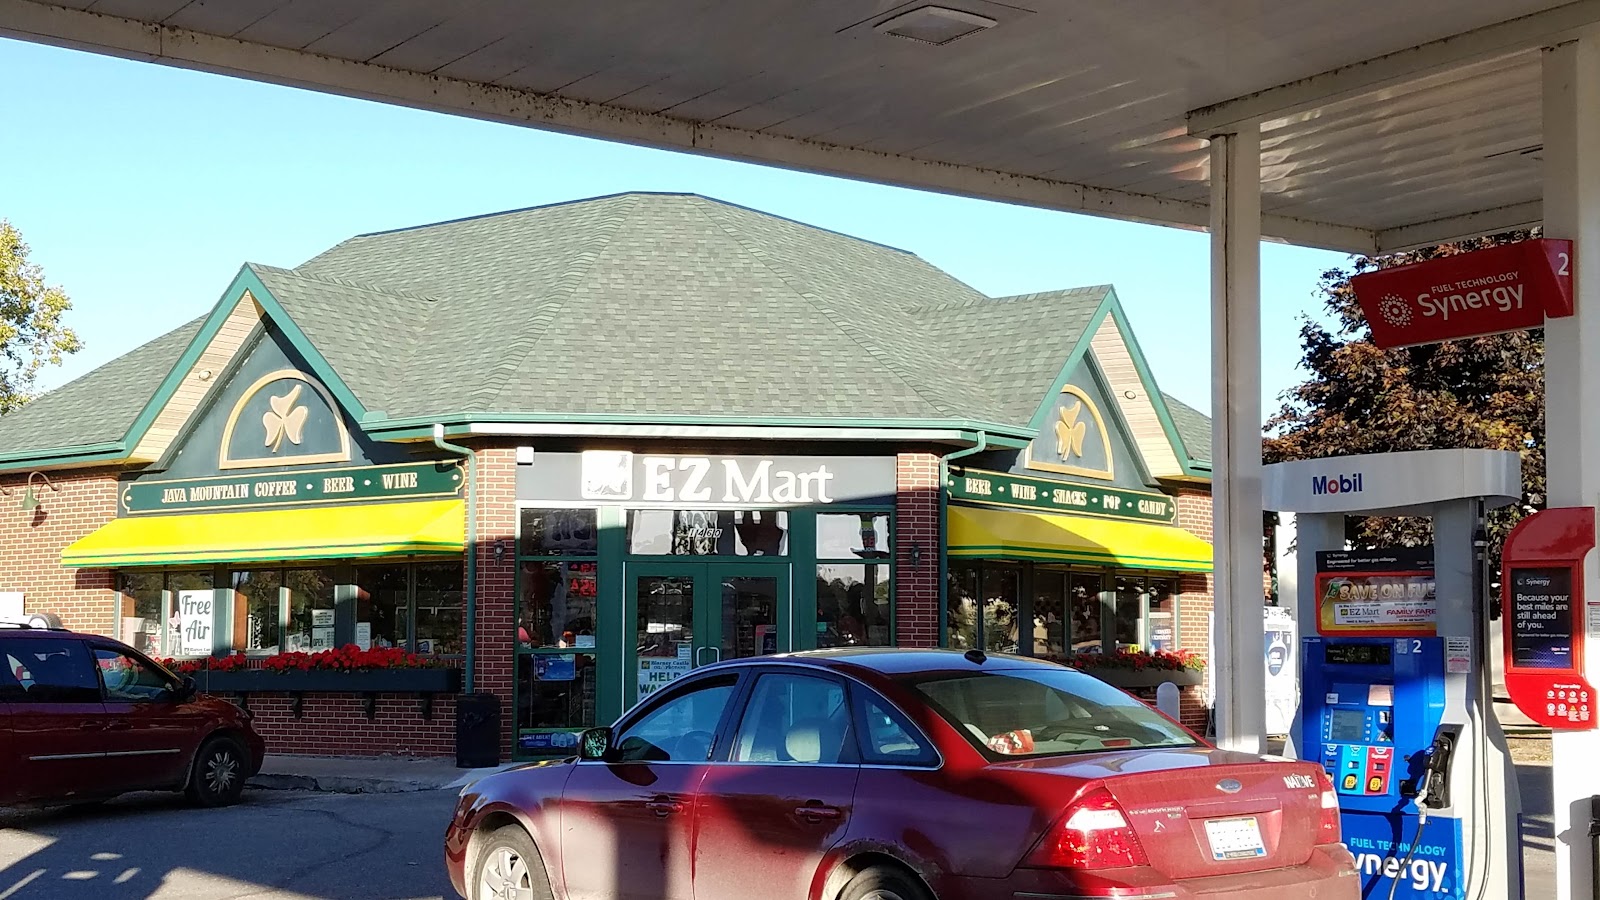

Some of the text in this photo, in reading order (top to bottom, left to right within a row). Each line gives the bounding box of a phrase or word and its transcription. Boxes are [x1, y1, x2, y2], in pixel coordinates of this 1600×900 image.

[1557, 252, 1570, 276] 2
[1431, 271, 1519, 294] FUEL TECHNOLOGY
[1417, 284, 1524, 320] Synergy
[161, 472, 418, 503] JAVA MOUNTAIN COFFEE BEER WINE
[643, 457, 834, 503] EZ Mart
[1312, 473, 1363, 495] Mobil
[965, 477, 1167, 516] BEER WINE SNACKS POP CANDY
[688, 527, 723, 538] 1460
[1340, 582, 1436, 600] SAVE ON FUE
[1525, 578, 1551, 586] Synergy
[181, 594, 211, 615] Free
[1516, 602, 1534, 610] best
[1534, 602, 1554, 610] miles
[1550, 595, 1569, 603] your
[1349, 608, 1380, 616] EZ Mart
[1516, 611, 1557, 619] still ahead
[185, 619, 210, 642] Air
[1516, 620, 1544, 630] of you.
[1412, 639, 1422, 653] 2
[1350, 837, 1375, 849] FUEL
[1340, 843, 1448, 893] ynergy
